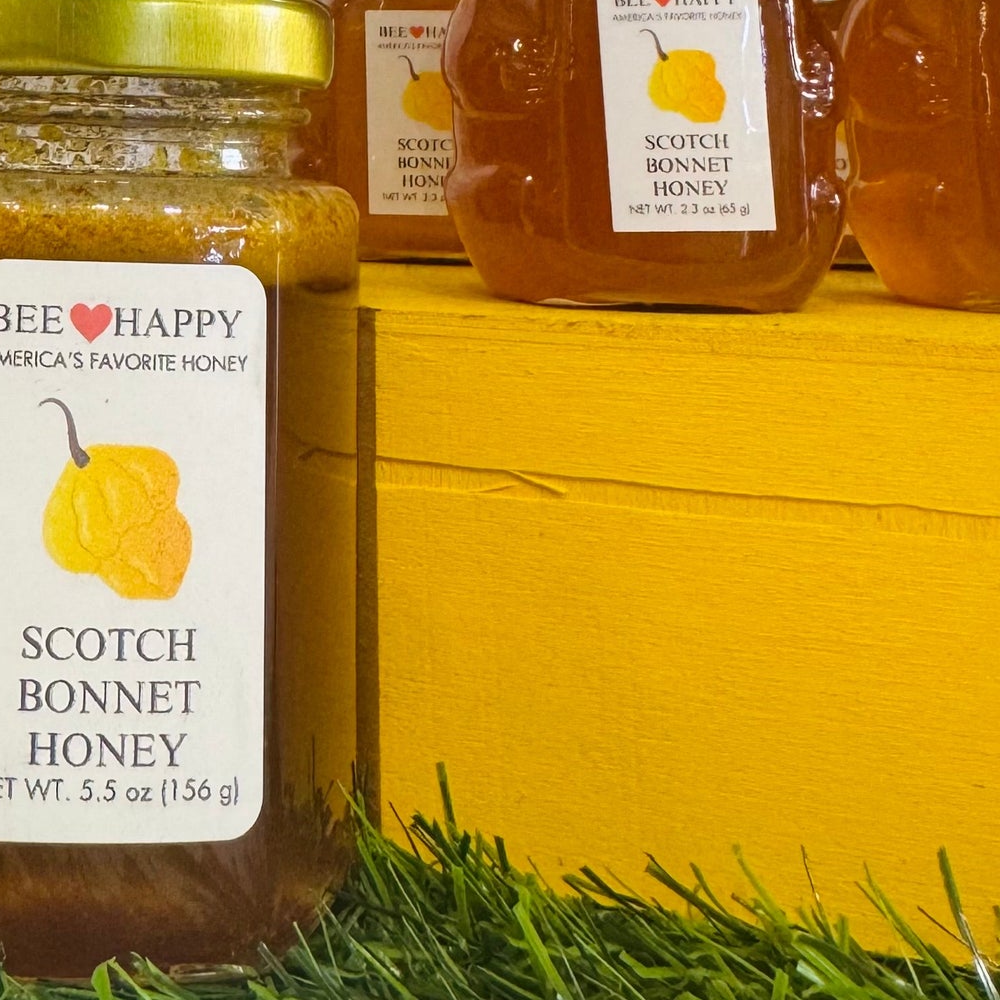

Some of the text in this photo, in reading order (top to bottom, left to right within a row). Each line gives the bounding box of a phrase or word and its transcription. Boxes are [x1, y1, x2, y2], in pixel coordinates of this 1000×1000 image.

[398, 138, 454, 152] SCOTC
[645, 133, 729, 150] SCOTCH
[646, 157, 733, 173] BONNET
[653, 180, 728, 197] HONEY
[114, 306, 242, 338] HAPPY
[90, 352, 176, 371] FAVORITE
[182, 355, 248, 373] HONEY
[21, 625, 197, 662] SCOTCH
[18, 678, 201, 714] BONNET
[28, 732, 187, 768] HONEY
[25, 778, 71, 801] WT.
[80, 779, 117, 802] 5.5
[125, 786, 152, 801] oz
[161, 779, 211, 807] (156
[219, 777, 239, 806] g)
